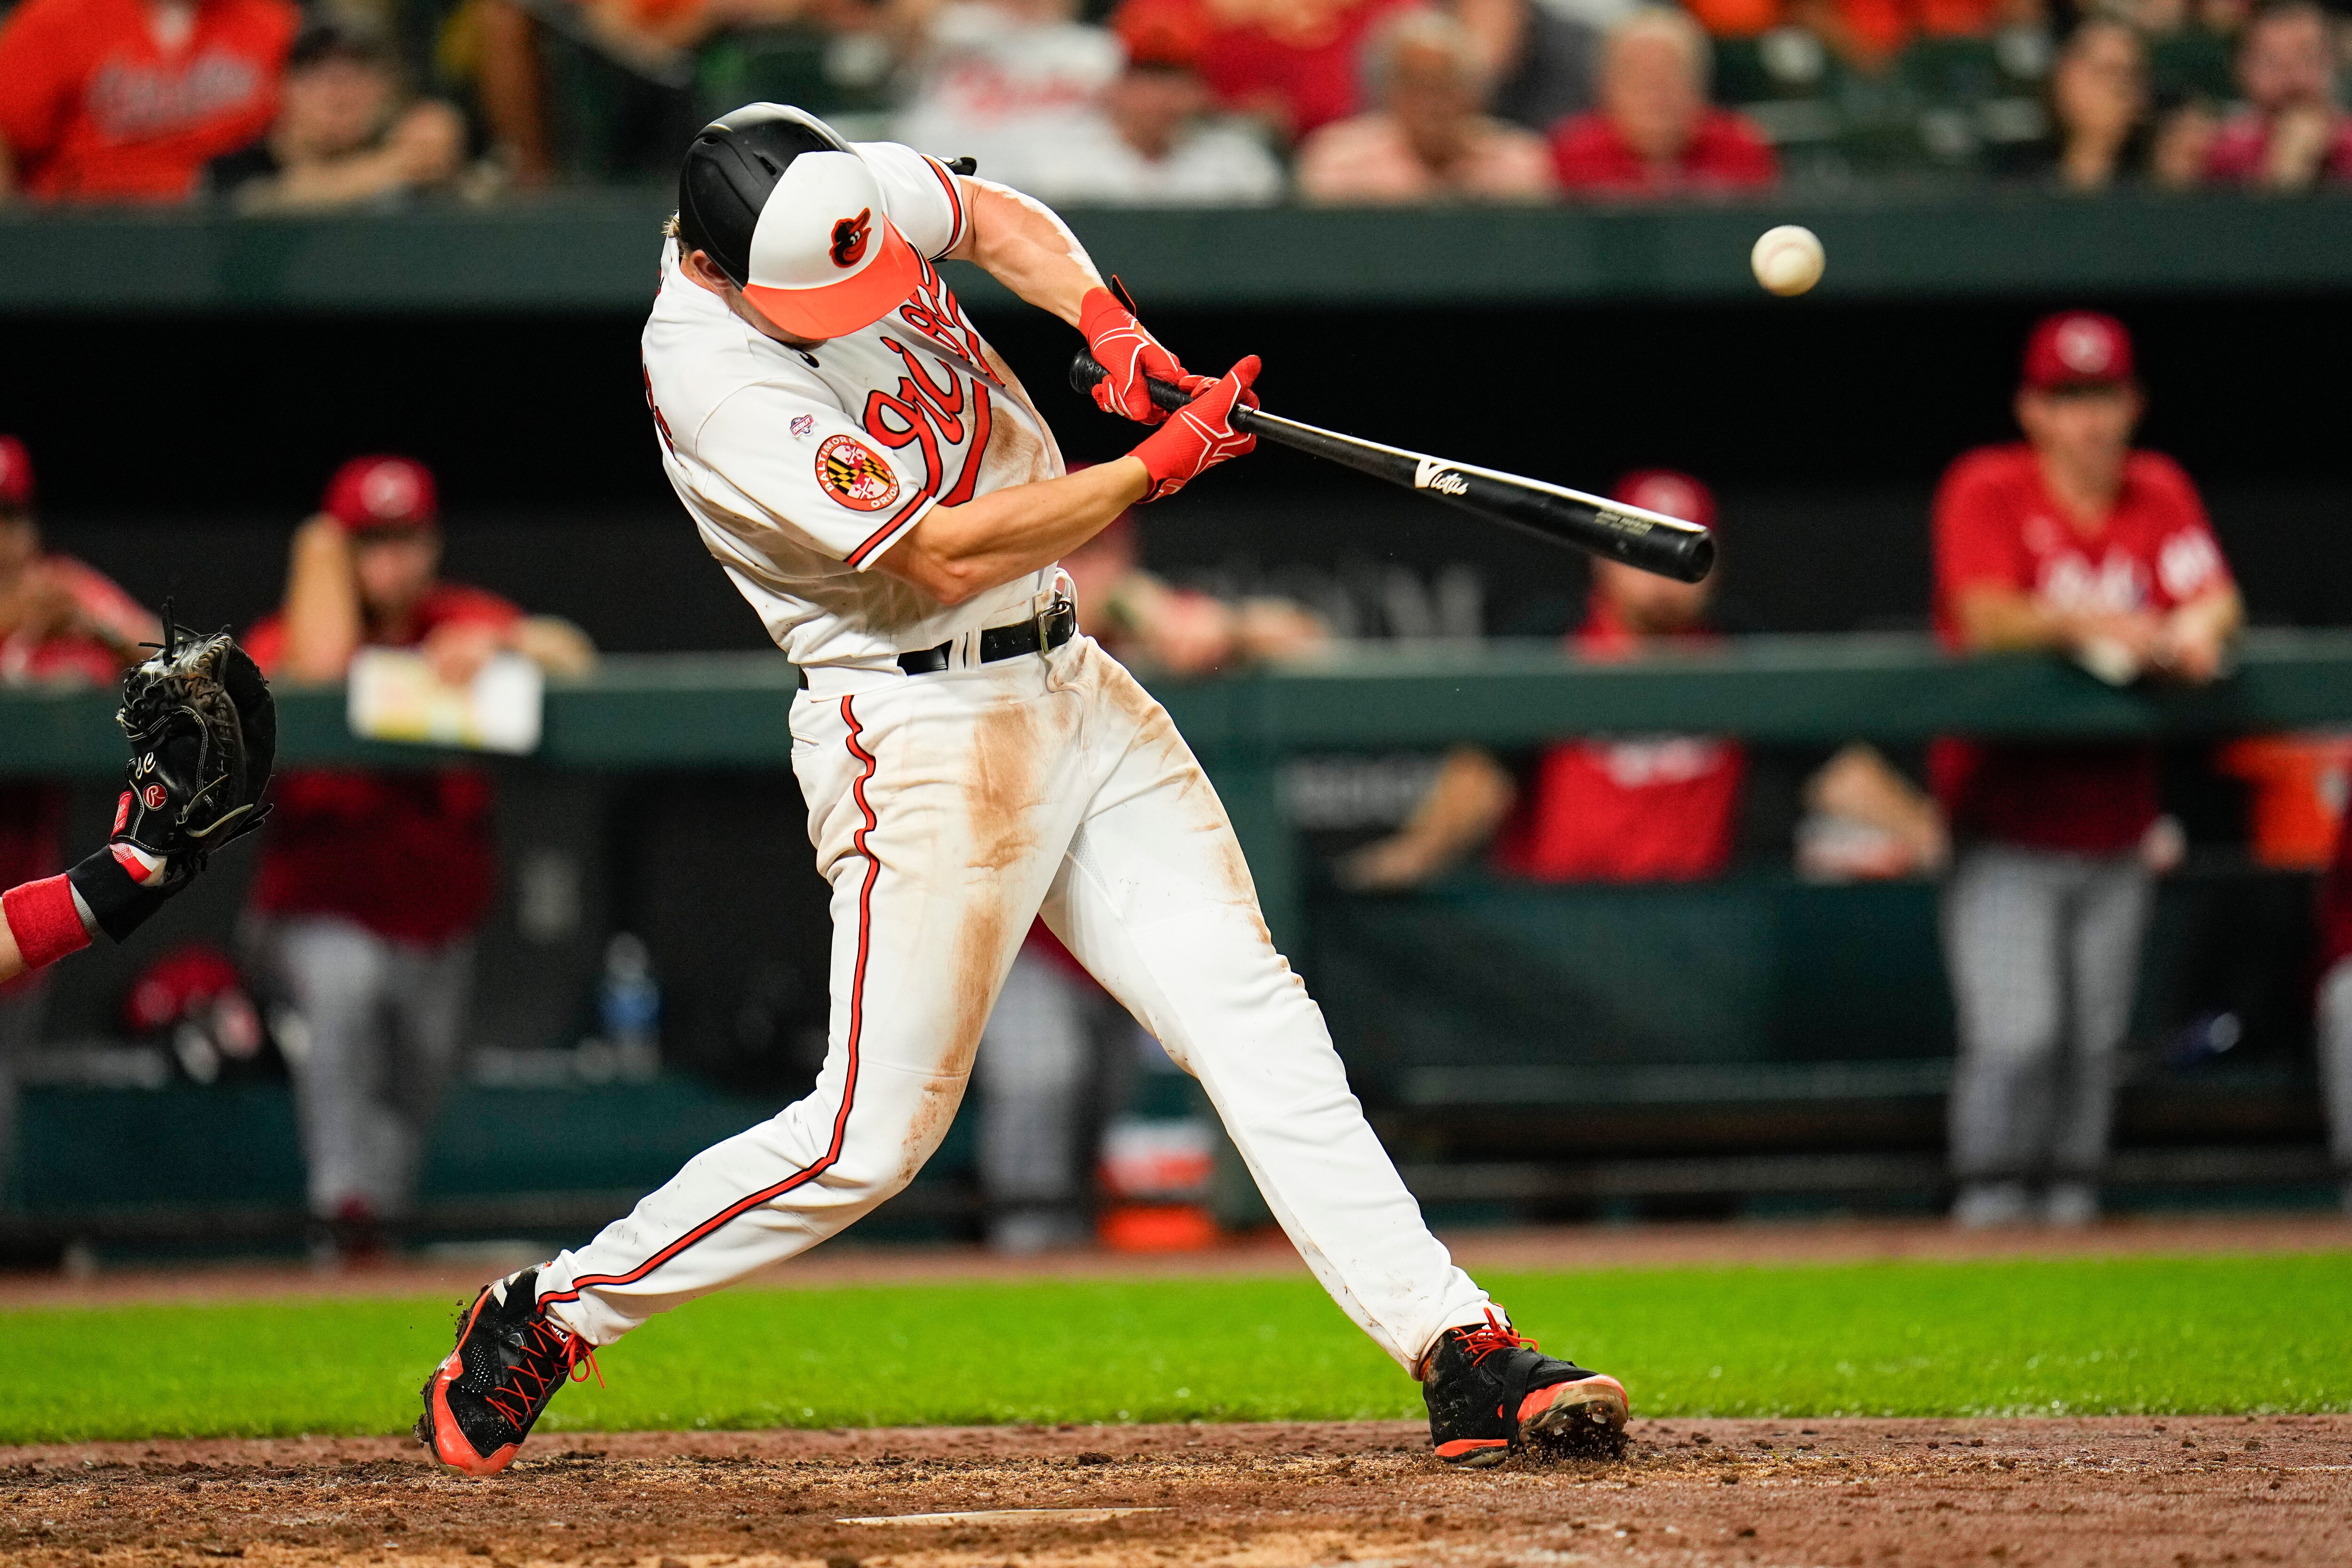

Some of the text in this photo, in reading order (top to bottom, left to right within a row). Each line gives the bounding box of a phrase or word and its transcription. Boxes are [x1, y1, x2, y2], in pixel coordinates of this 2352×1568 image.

[793, 417, 811, 433] DEBUT
[818, 436, 857, 492] BALTIMORE
[871, 470, 898, 508] ORIOLES
